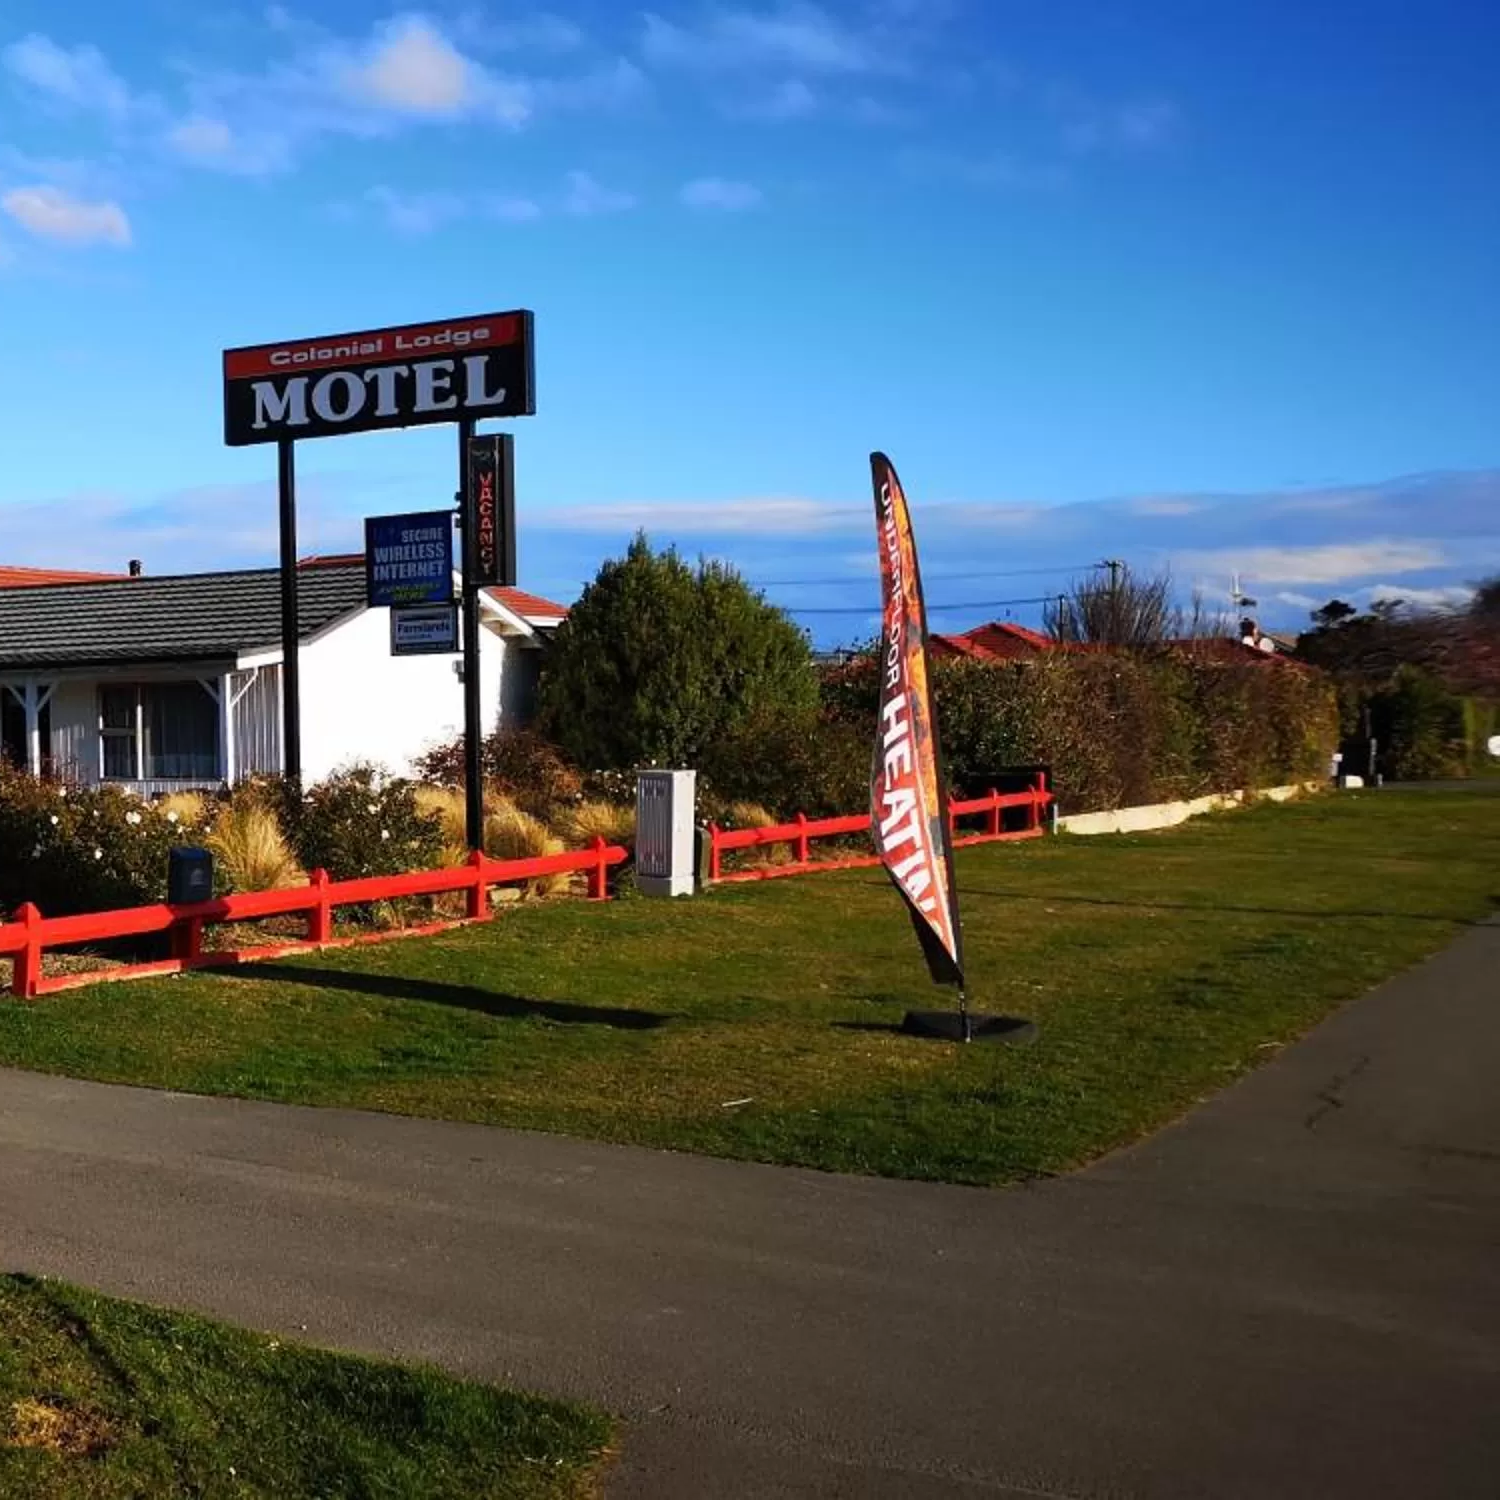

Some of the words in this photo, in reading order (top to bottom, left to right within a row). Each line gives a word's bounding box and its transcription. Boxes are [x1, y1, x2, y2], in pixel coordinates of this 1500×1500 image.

[269, 338, 383, 365] Colonial
[395, 327, 490, 350] Lodge
[251, 355, 506, 429] MOTEL
[374, 541, 445, 563] WIRELESS
[401, 527, 444, 543] SECURE
[479, 471, 495, 577] VACANCY
[374, 559, 445, 581] INTERNET
[881, 483, 903, 688] UNDERFLOOR
[880, 692, 943, 939] HEATIN
